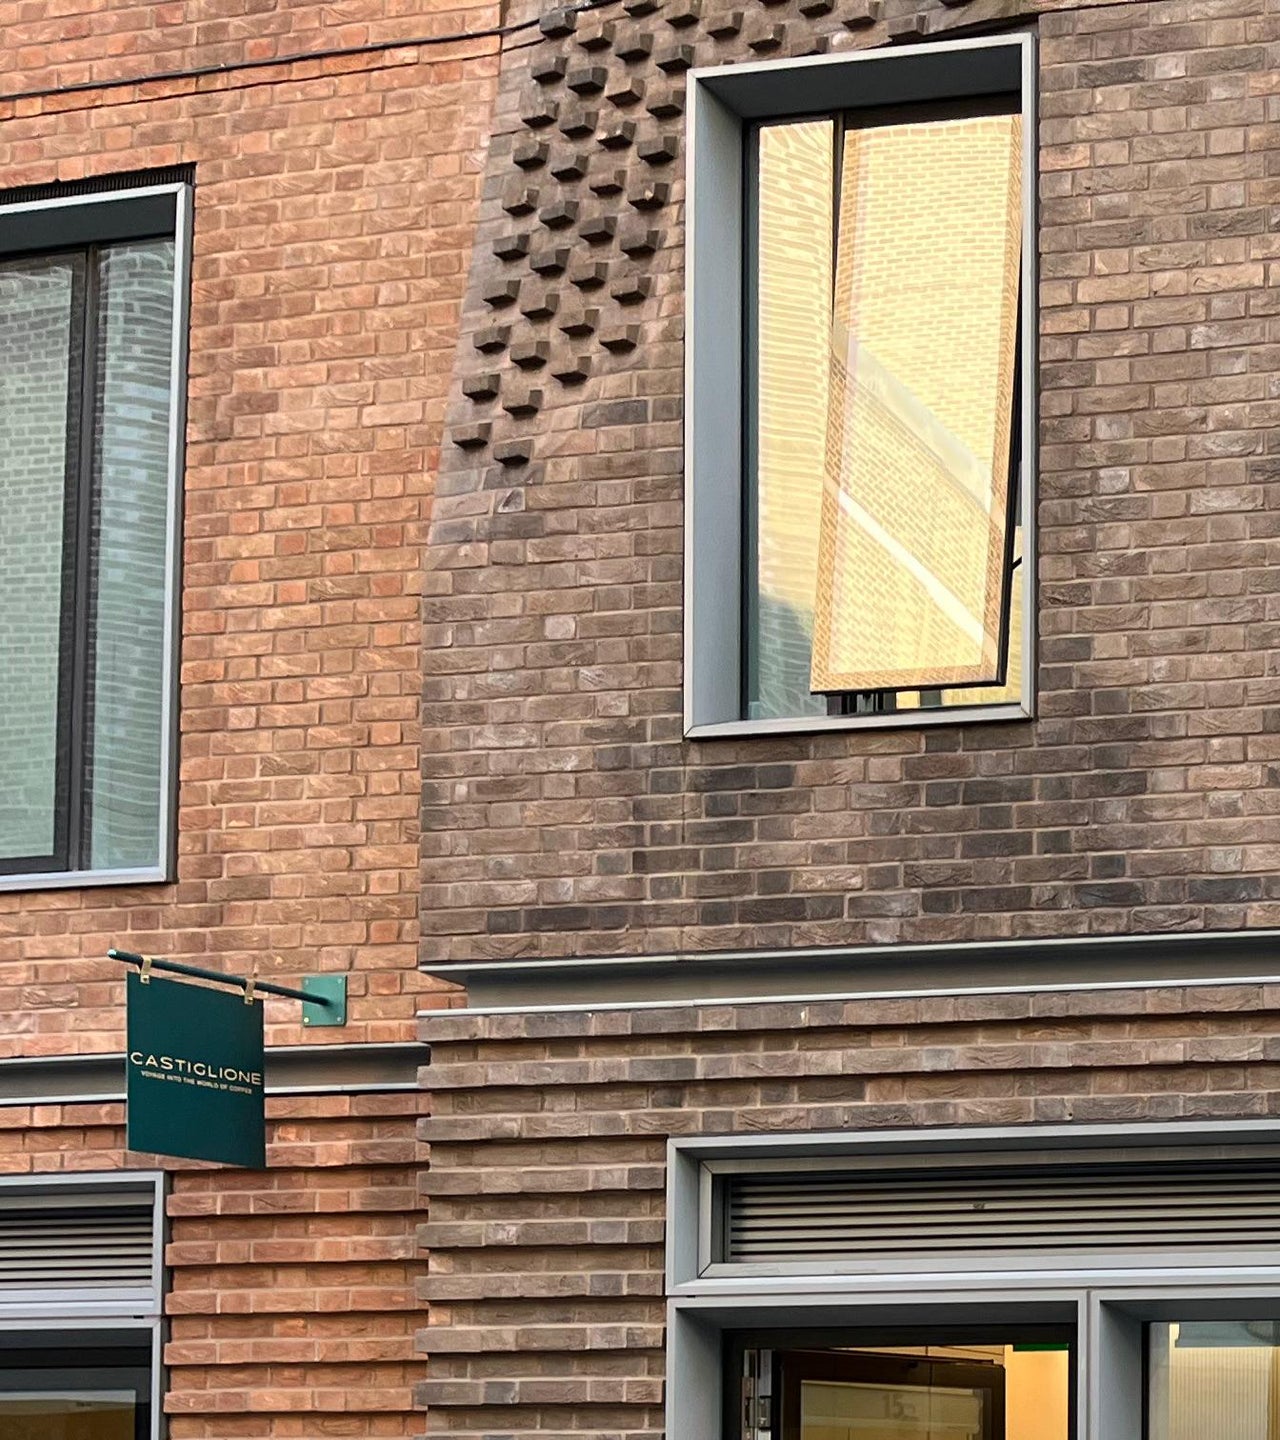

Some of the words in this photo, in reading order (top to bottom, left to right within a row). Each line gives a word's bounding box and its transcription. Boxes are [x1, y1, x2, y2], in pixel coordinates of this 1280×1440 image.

[130, 1052, 261, 1085] CASTIGLIONE
[183, 1077, 196, 1085] THE
[196, 1079, 219, 1089] WORLD
[219, 1083, 229, 1091] OF
